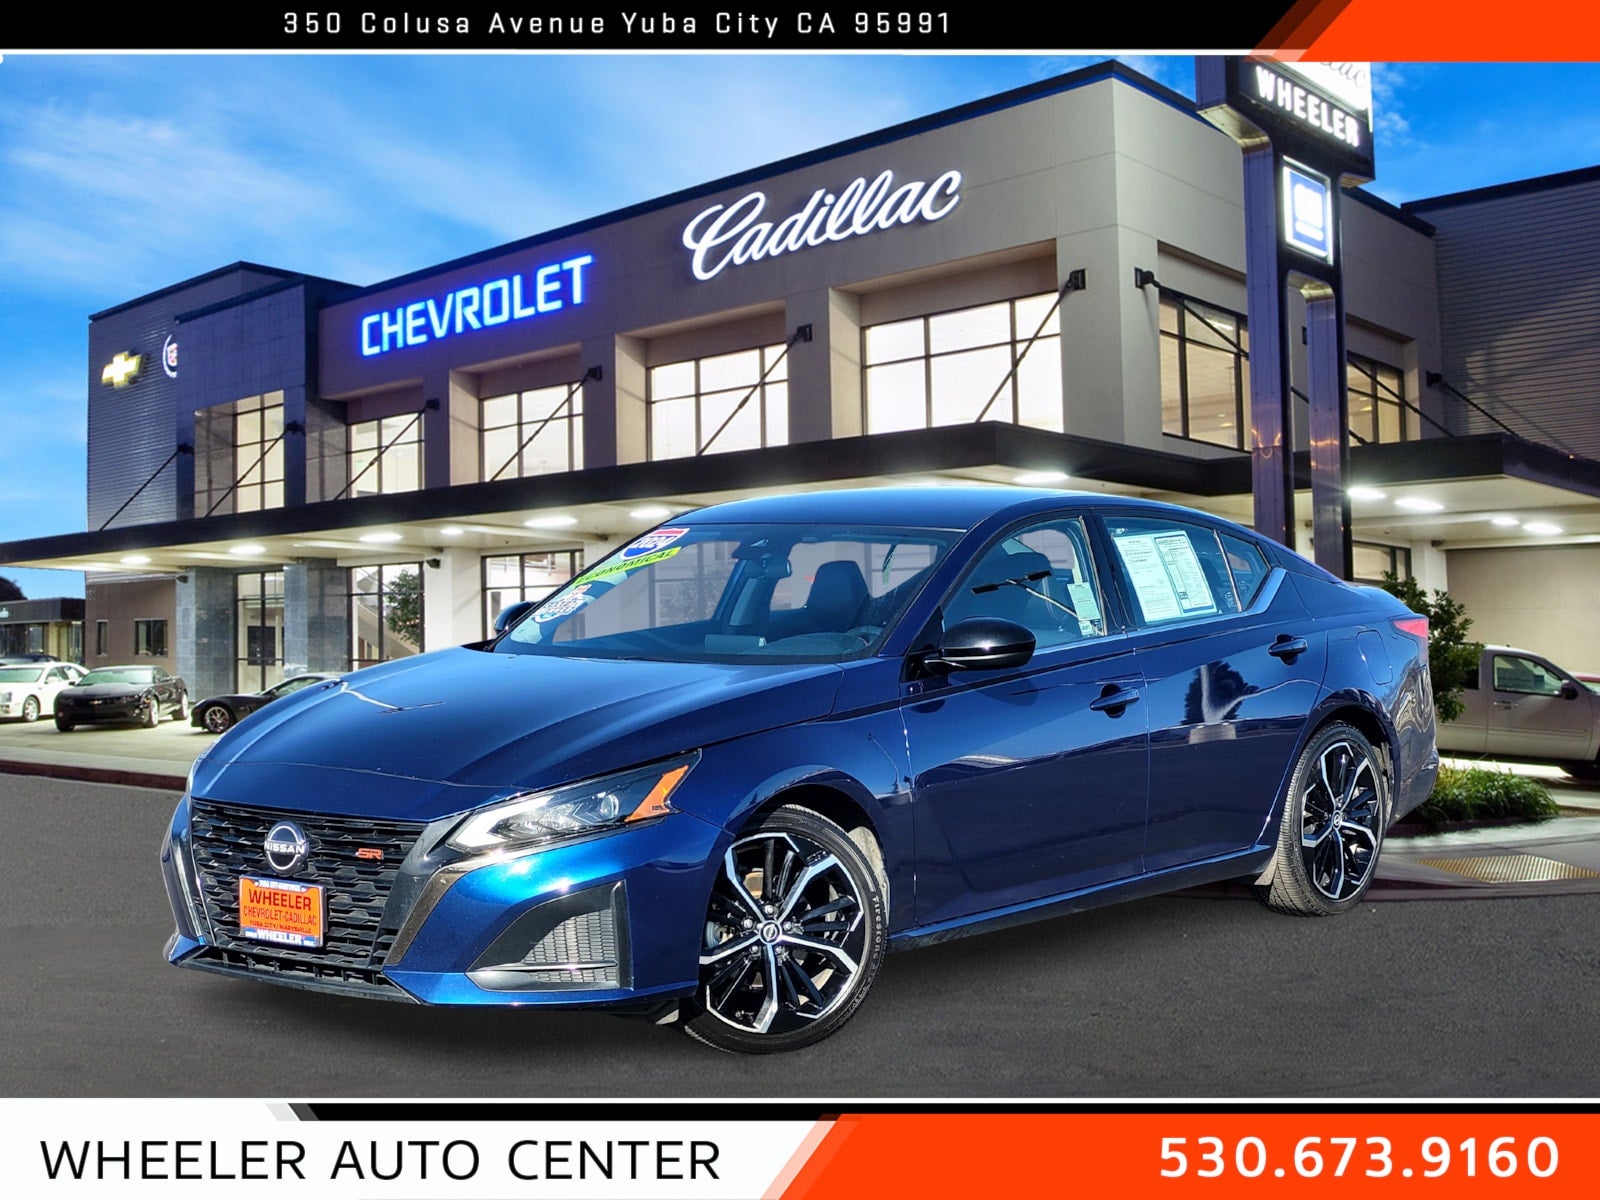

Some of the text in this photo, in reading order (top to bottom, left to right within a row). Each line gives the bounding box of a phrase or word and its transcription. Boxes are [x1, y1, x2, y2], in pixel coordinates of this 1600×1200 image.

[1255, 64, 1360, 148] WHEELER
[682, 168, 963, 281] Cadillac
[361, 254, 593, 357] CHEVROLET
[575, 550, 674, 584] ECONOMICAL
[264, 840, 306, 855] NISSAN
[356, 848, 382, 860] SR
[243, 905, 317, 926] CHEVROLET-CADILLAC
[248, 888, 312, 911] WHEELER
[871, 894, 883, 960] Firestone
